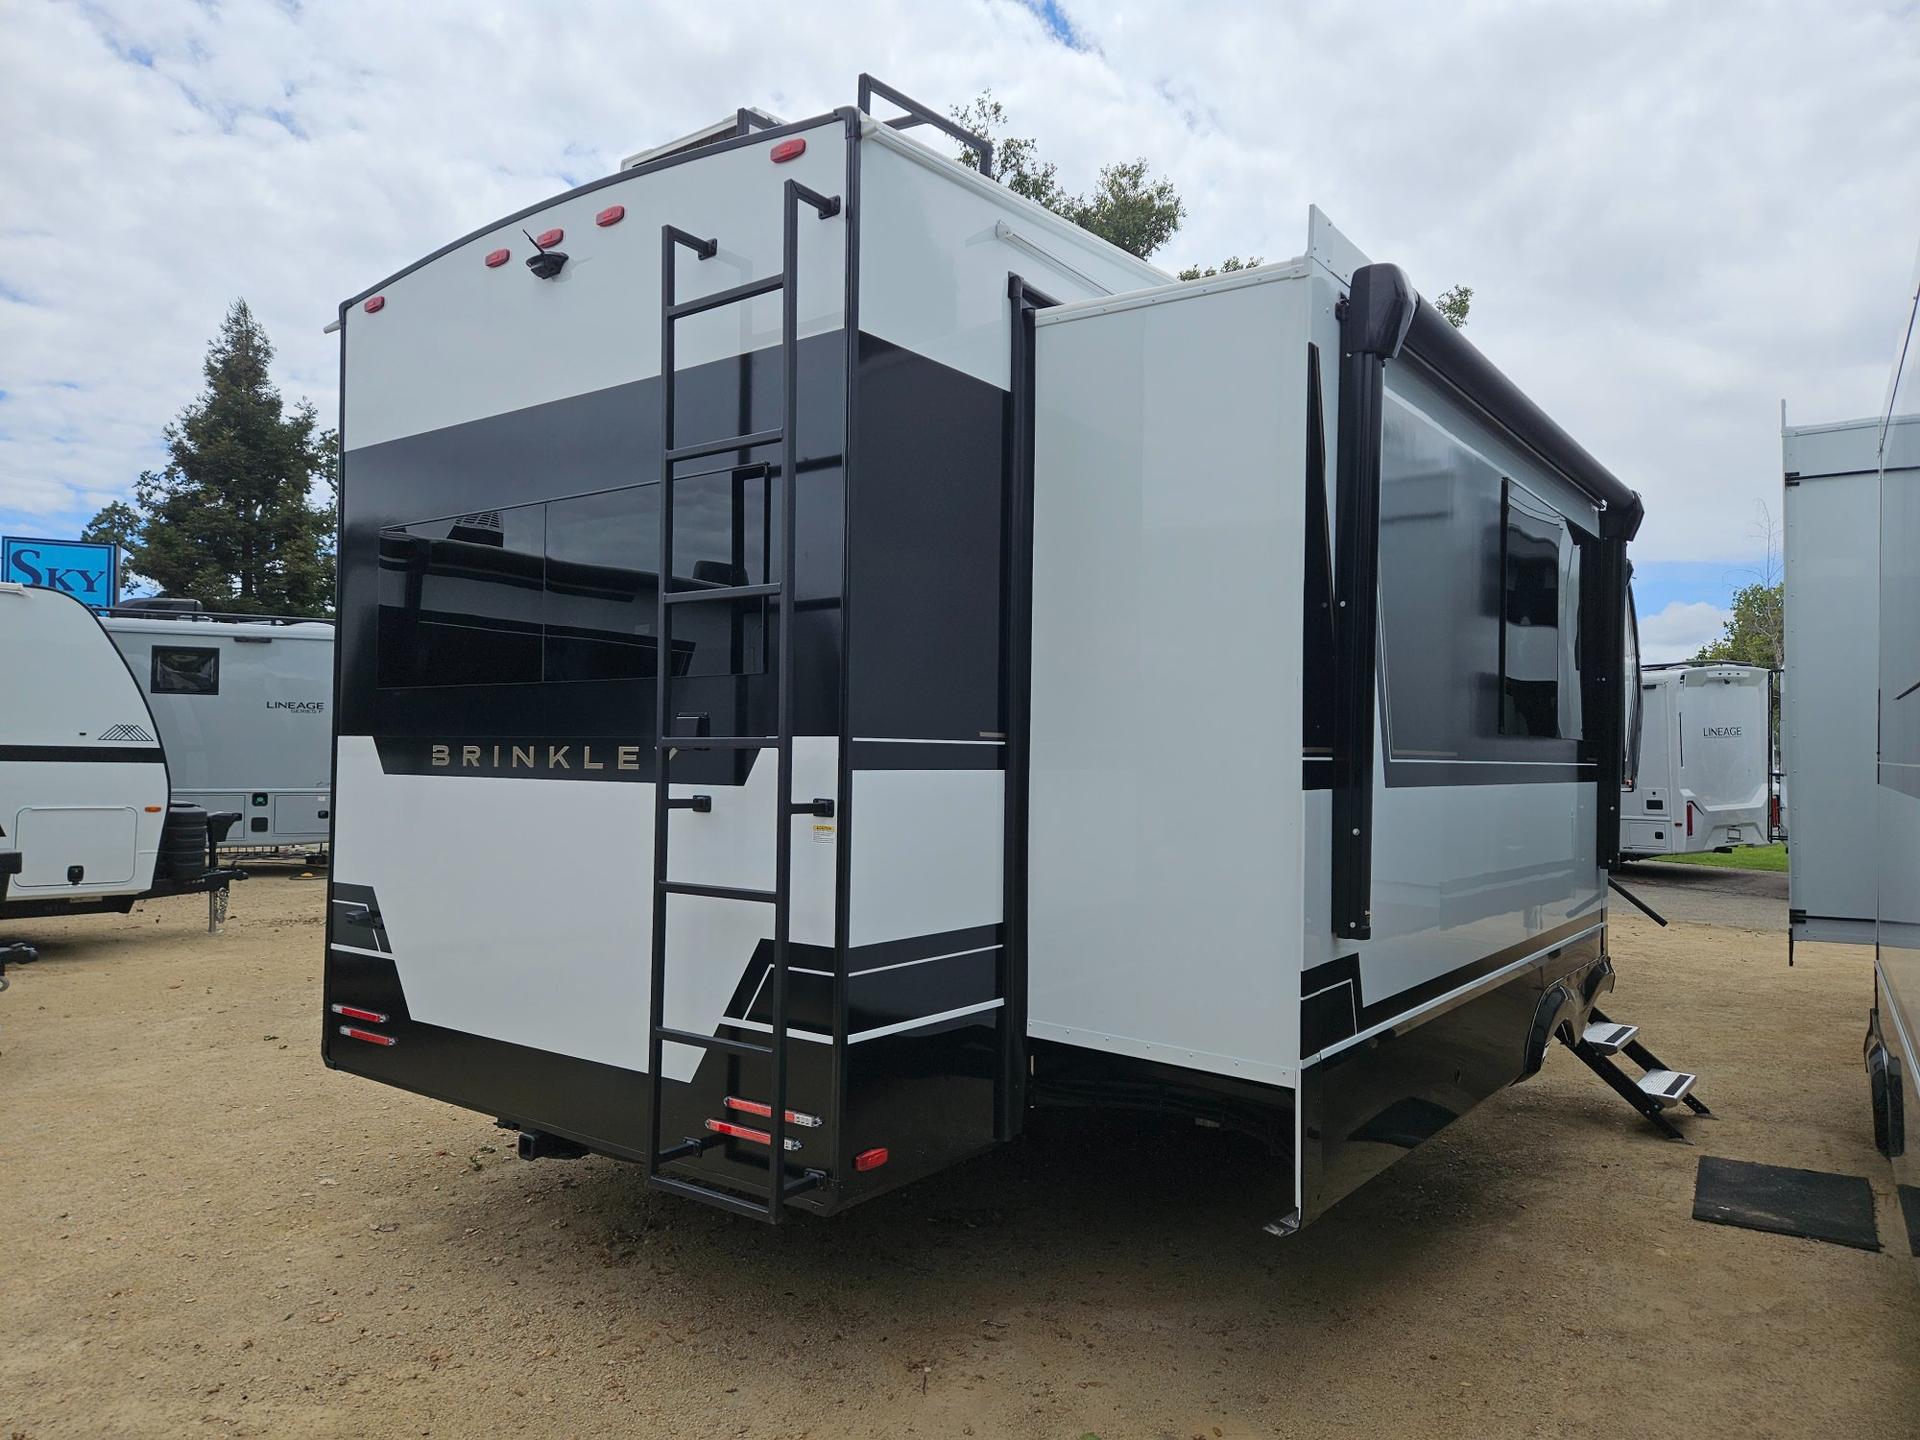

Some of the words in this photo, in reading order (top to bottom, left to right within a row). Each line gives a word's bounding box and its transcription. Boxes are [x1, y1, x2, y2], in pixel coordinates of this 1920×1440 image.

[12, 549, 105, 592] SKY
[266, 701, 325, 709] LINEAGE
[1703, 727, 1742, 737] LINEAGE
[432, 744, 678, 770] BRINKLE
